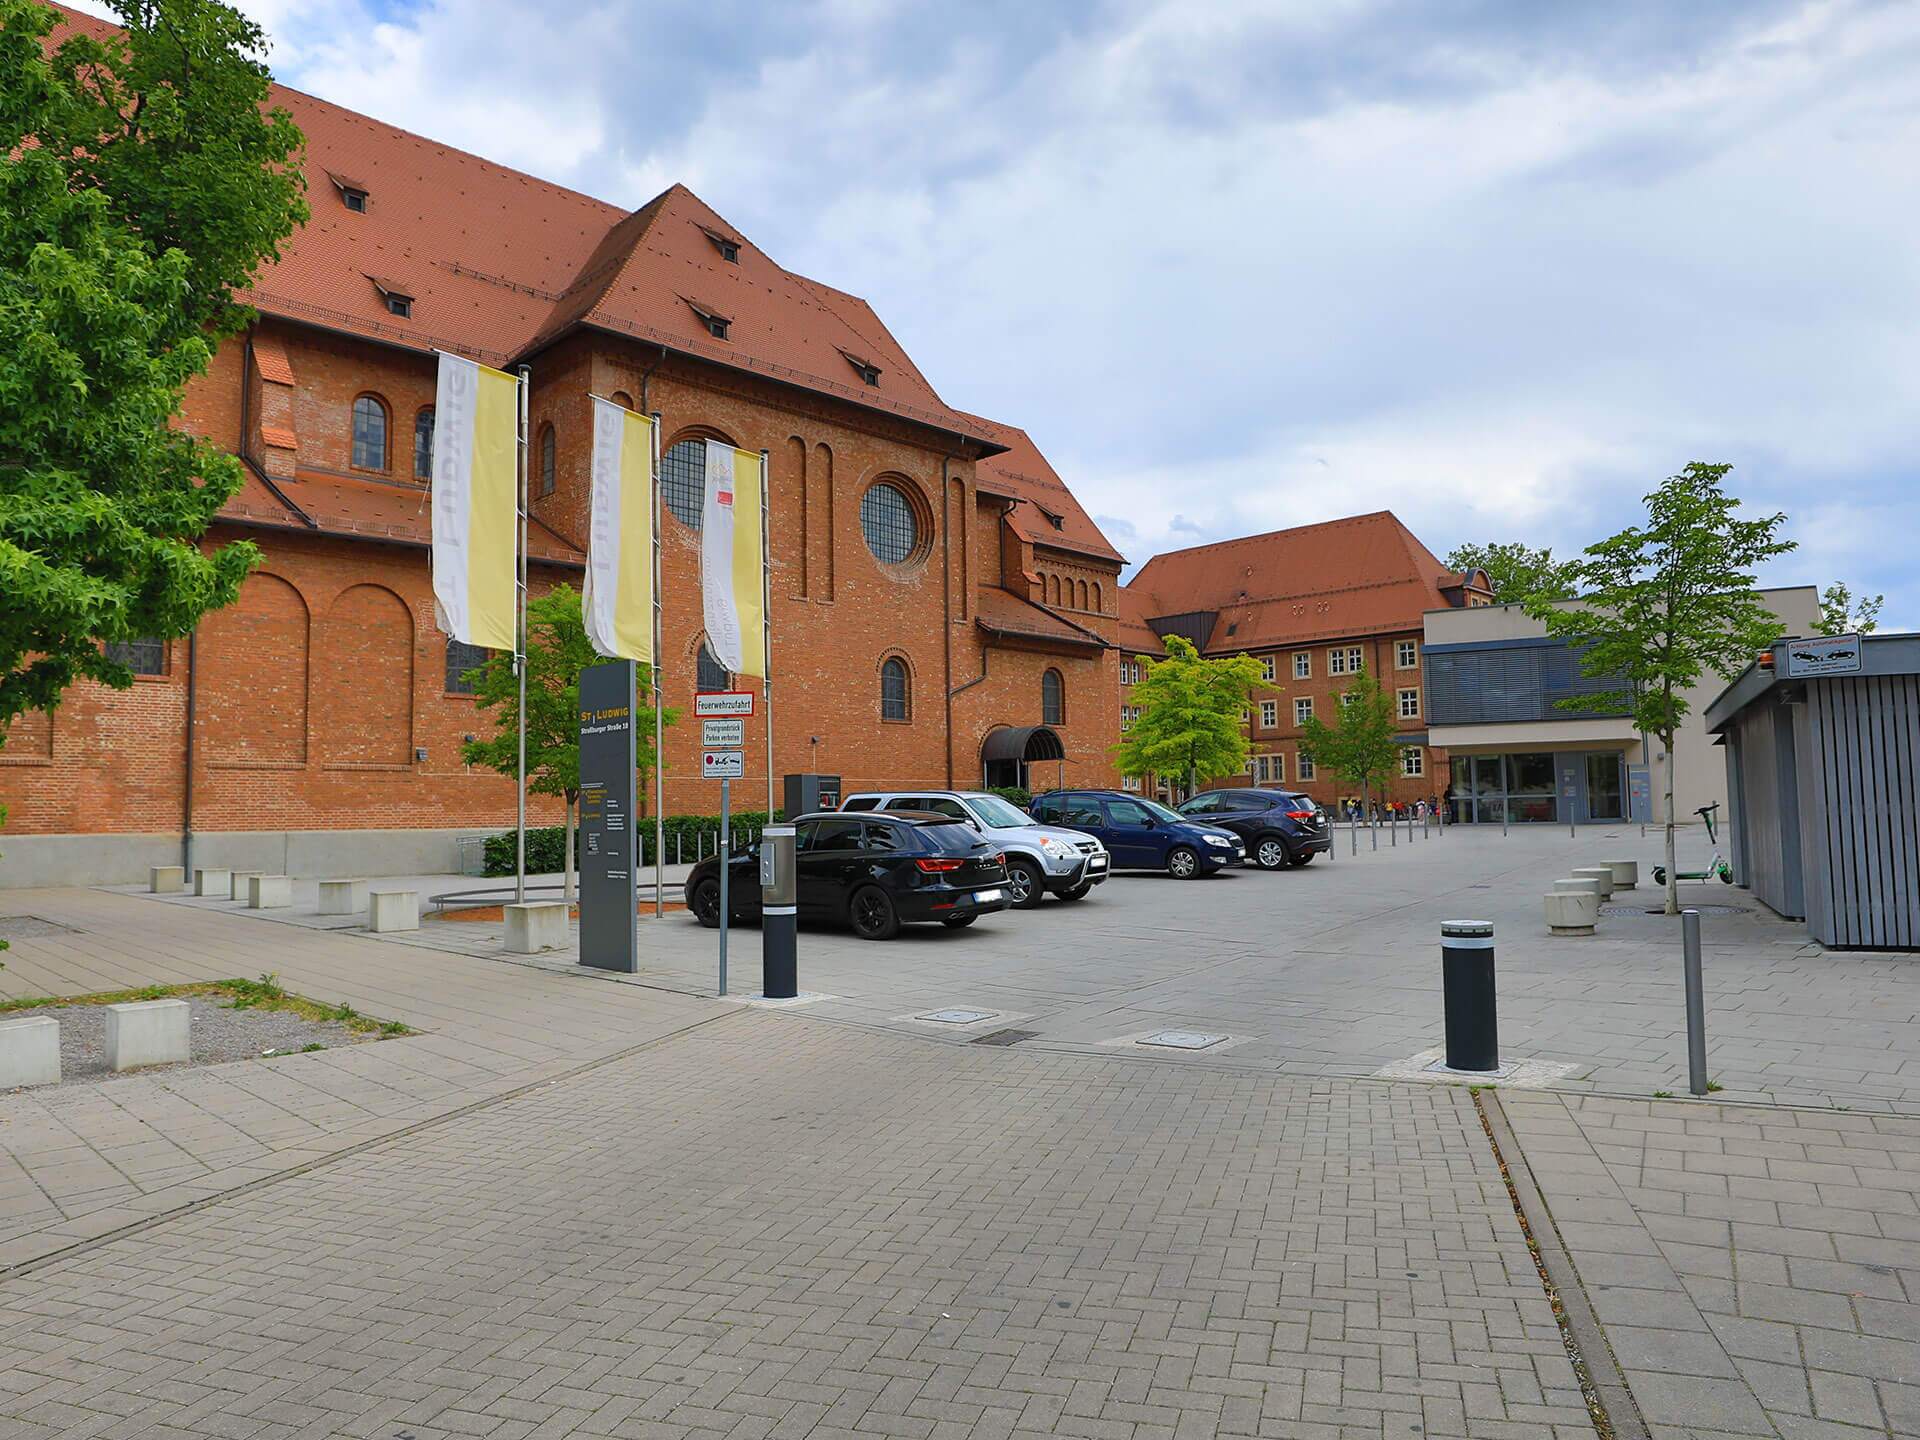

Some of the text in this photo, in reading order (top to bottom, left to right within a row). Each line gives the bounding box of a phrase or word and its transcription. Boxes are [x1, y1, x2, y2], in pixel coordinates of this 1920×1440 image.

[697, 700, 751, 710] Feuerwehrzufahrt
[580, 707, 629, 721] ST LUDWIG
